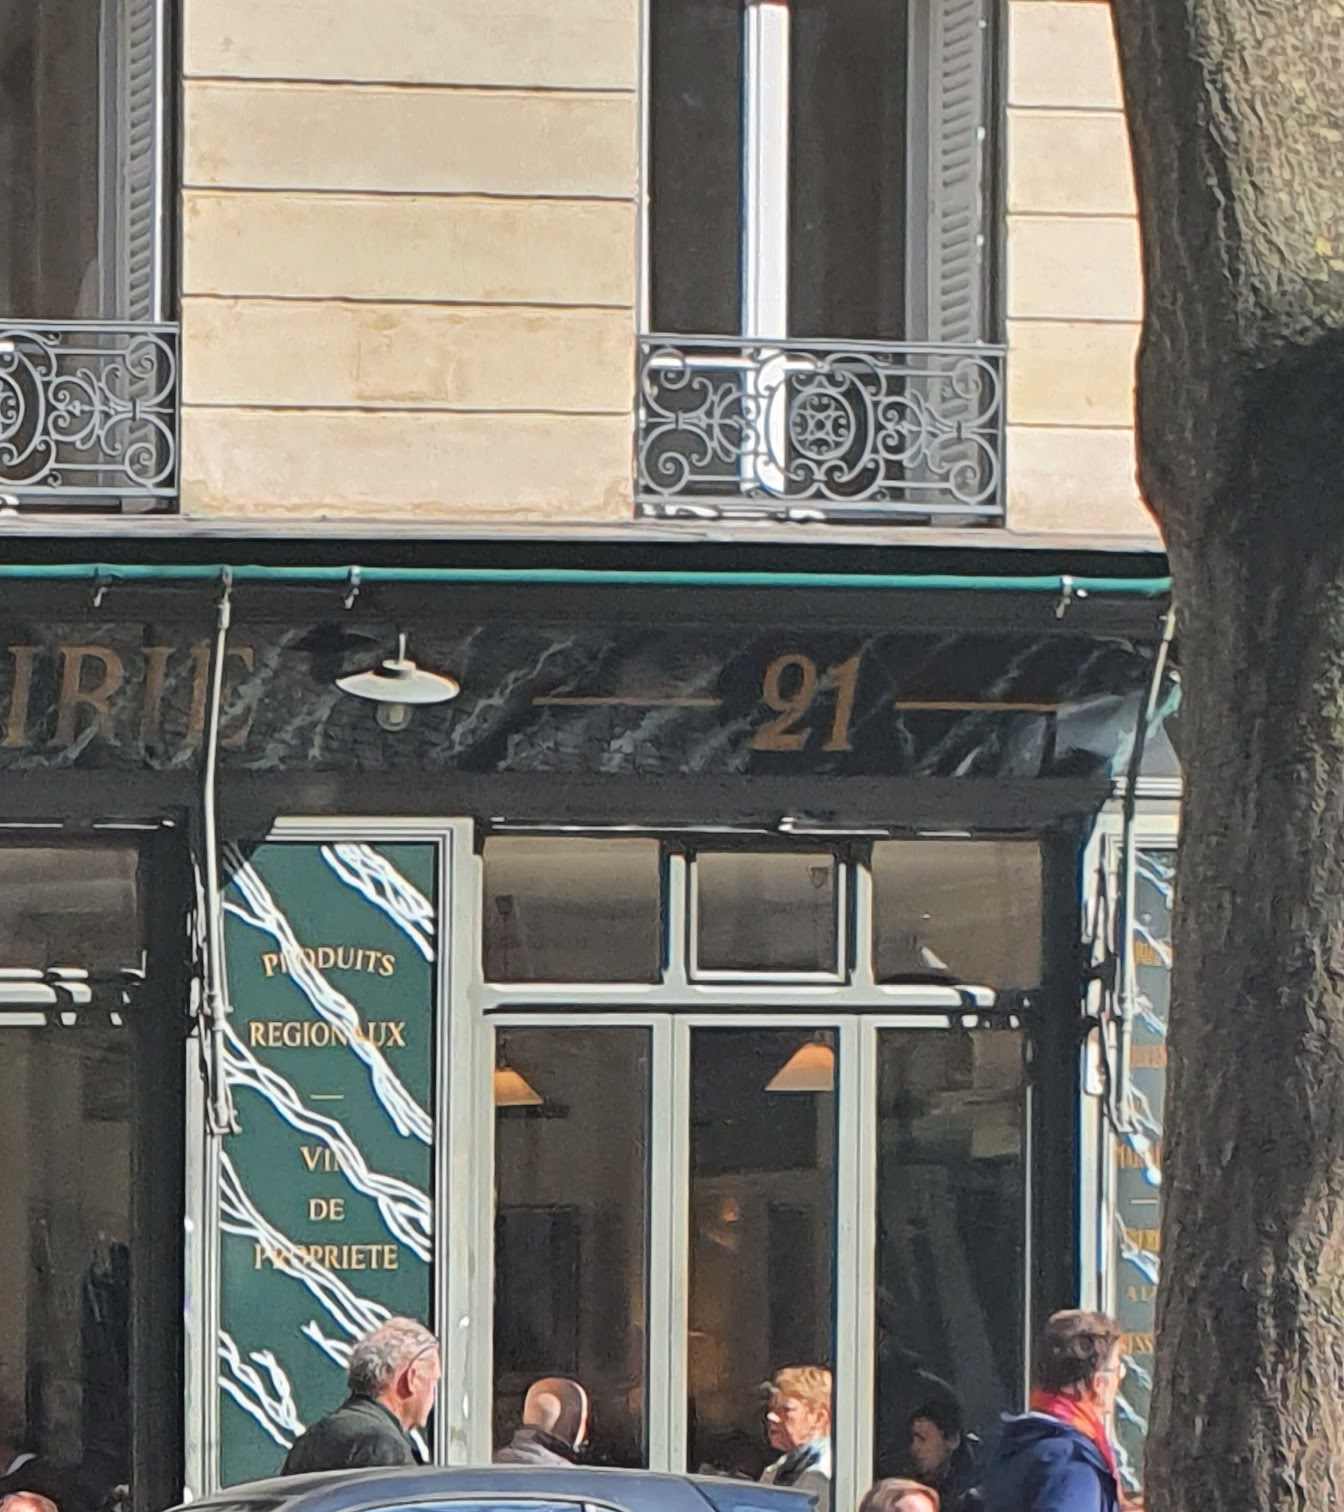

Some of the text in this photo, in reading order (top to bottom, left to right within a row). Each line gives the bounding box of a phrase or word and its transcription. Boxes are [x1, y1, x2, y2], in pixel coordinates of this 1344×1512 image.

[750, 652, 862, 753] 21
[248, 1020, 407, 1048] REGIONAUX
[308, 1197, 346, 1222] DE
